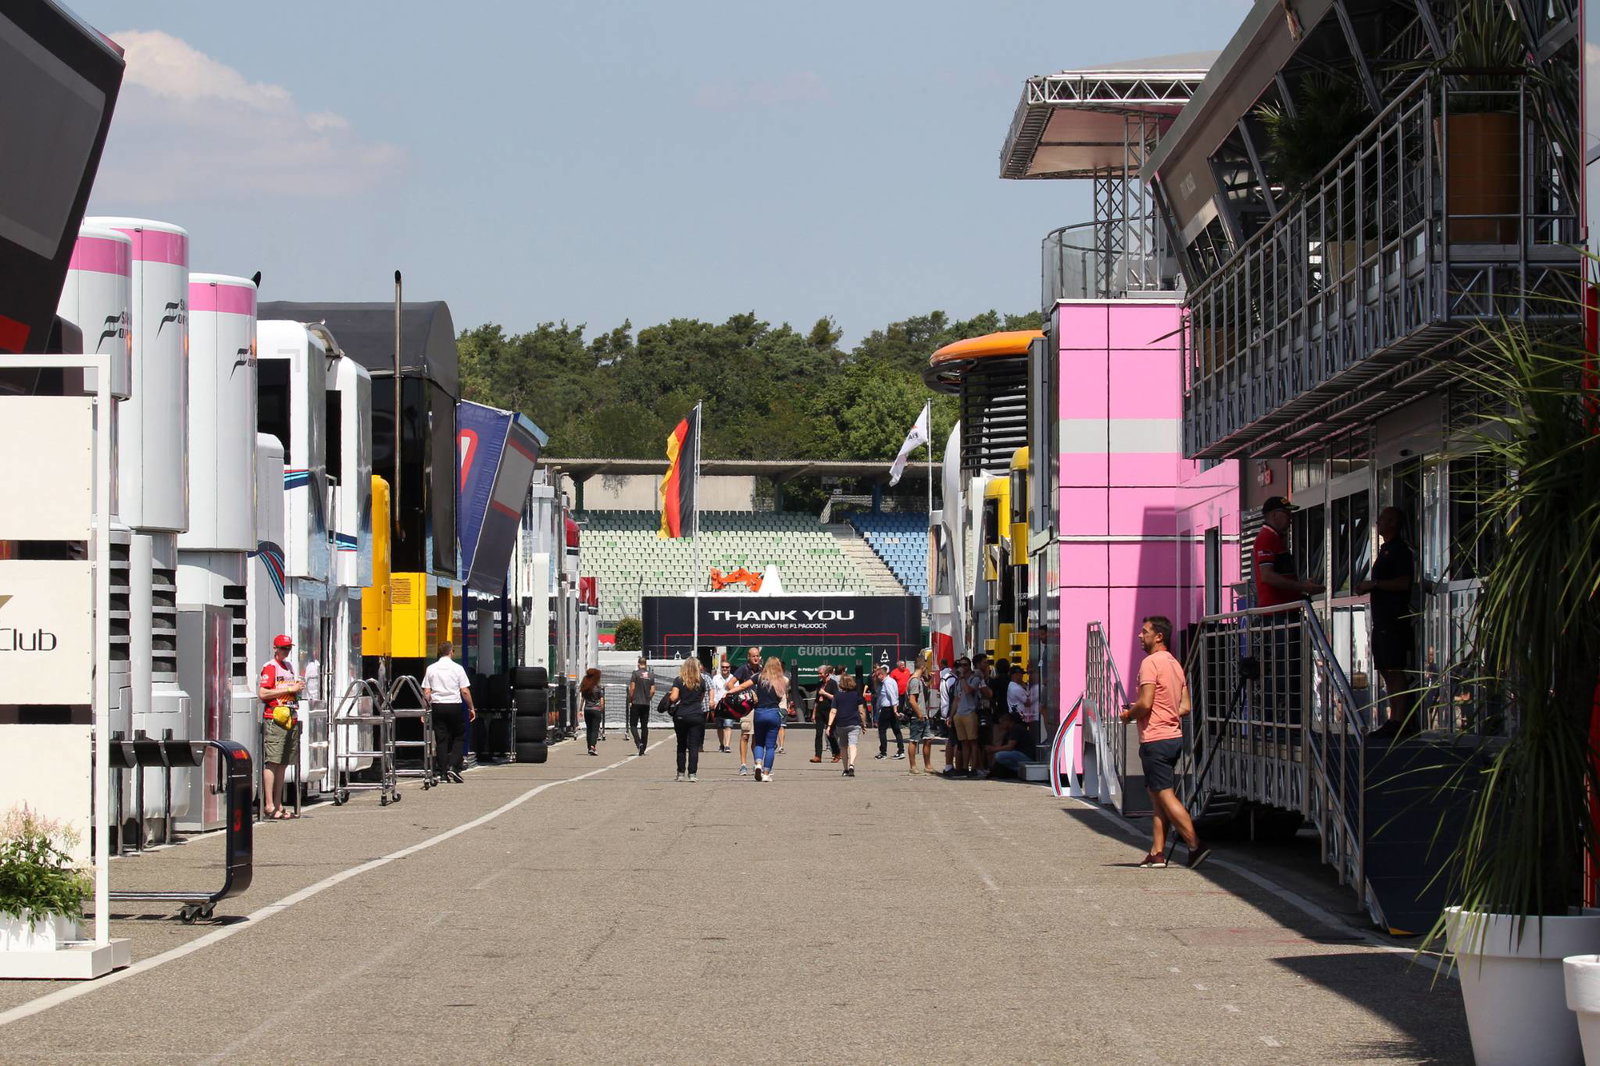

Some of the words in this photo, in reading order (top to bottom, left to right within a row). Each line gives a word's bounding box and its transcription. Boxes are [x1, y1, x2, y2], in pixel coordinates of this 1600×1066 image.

[708, 610, 798, 621] THANK
[802, 610, 855, 621] YOU
[797, 646, 856, 656] GURDULIC
